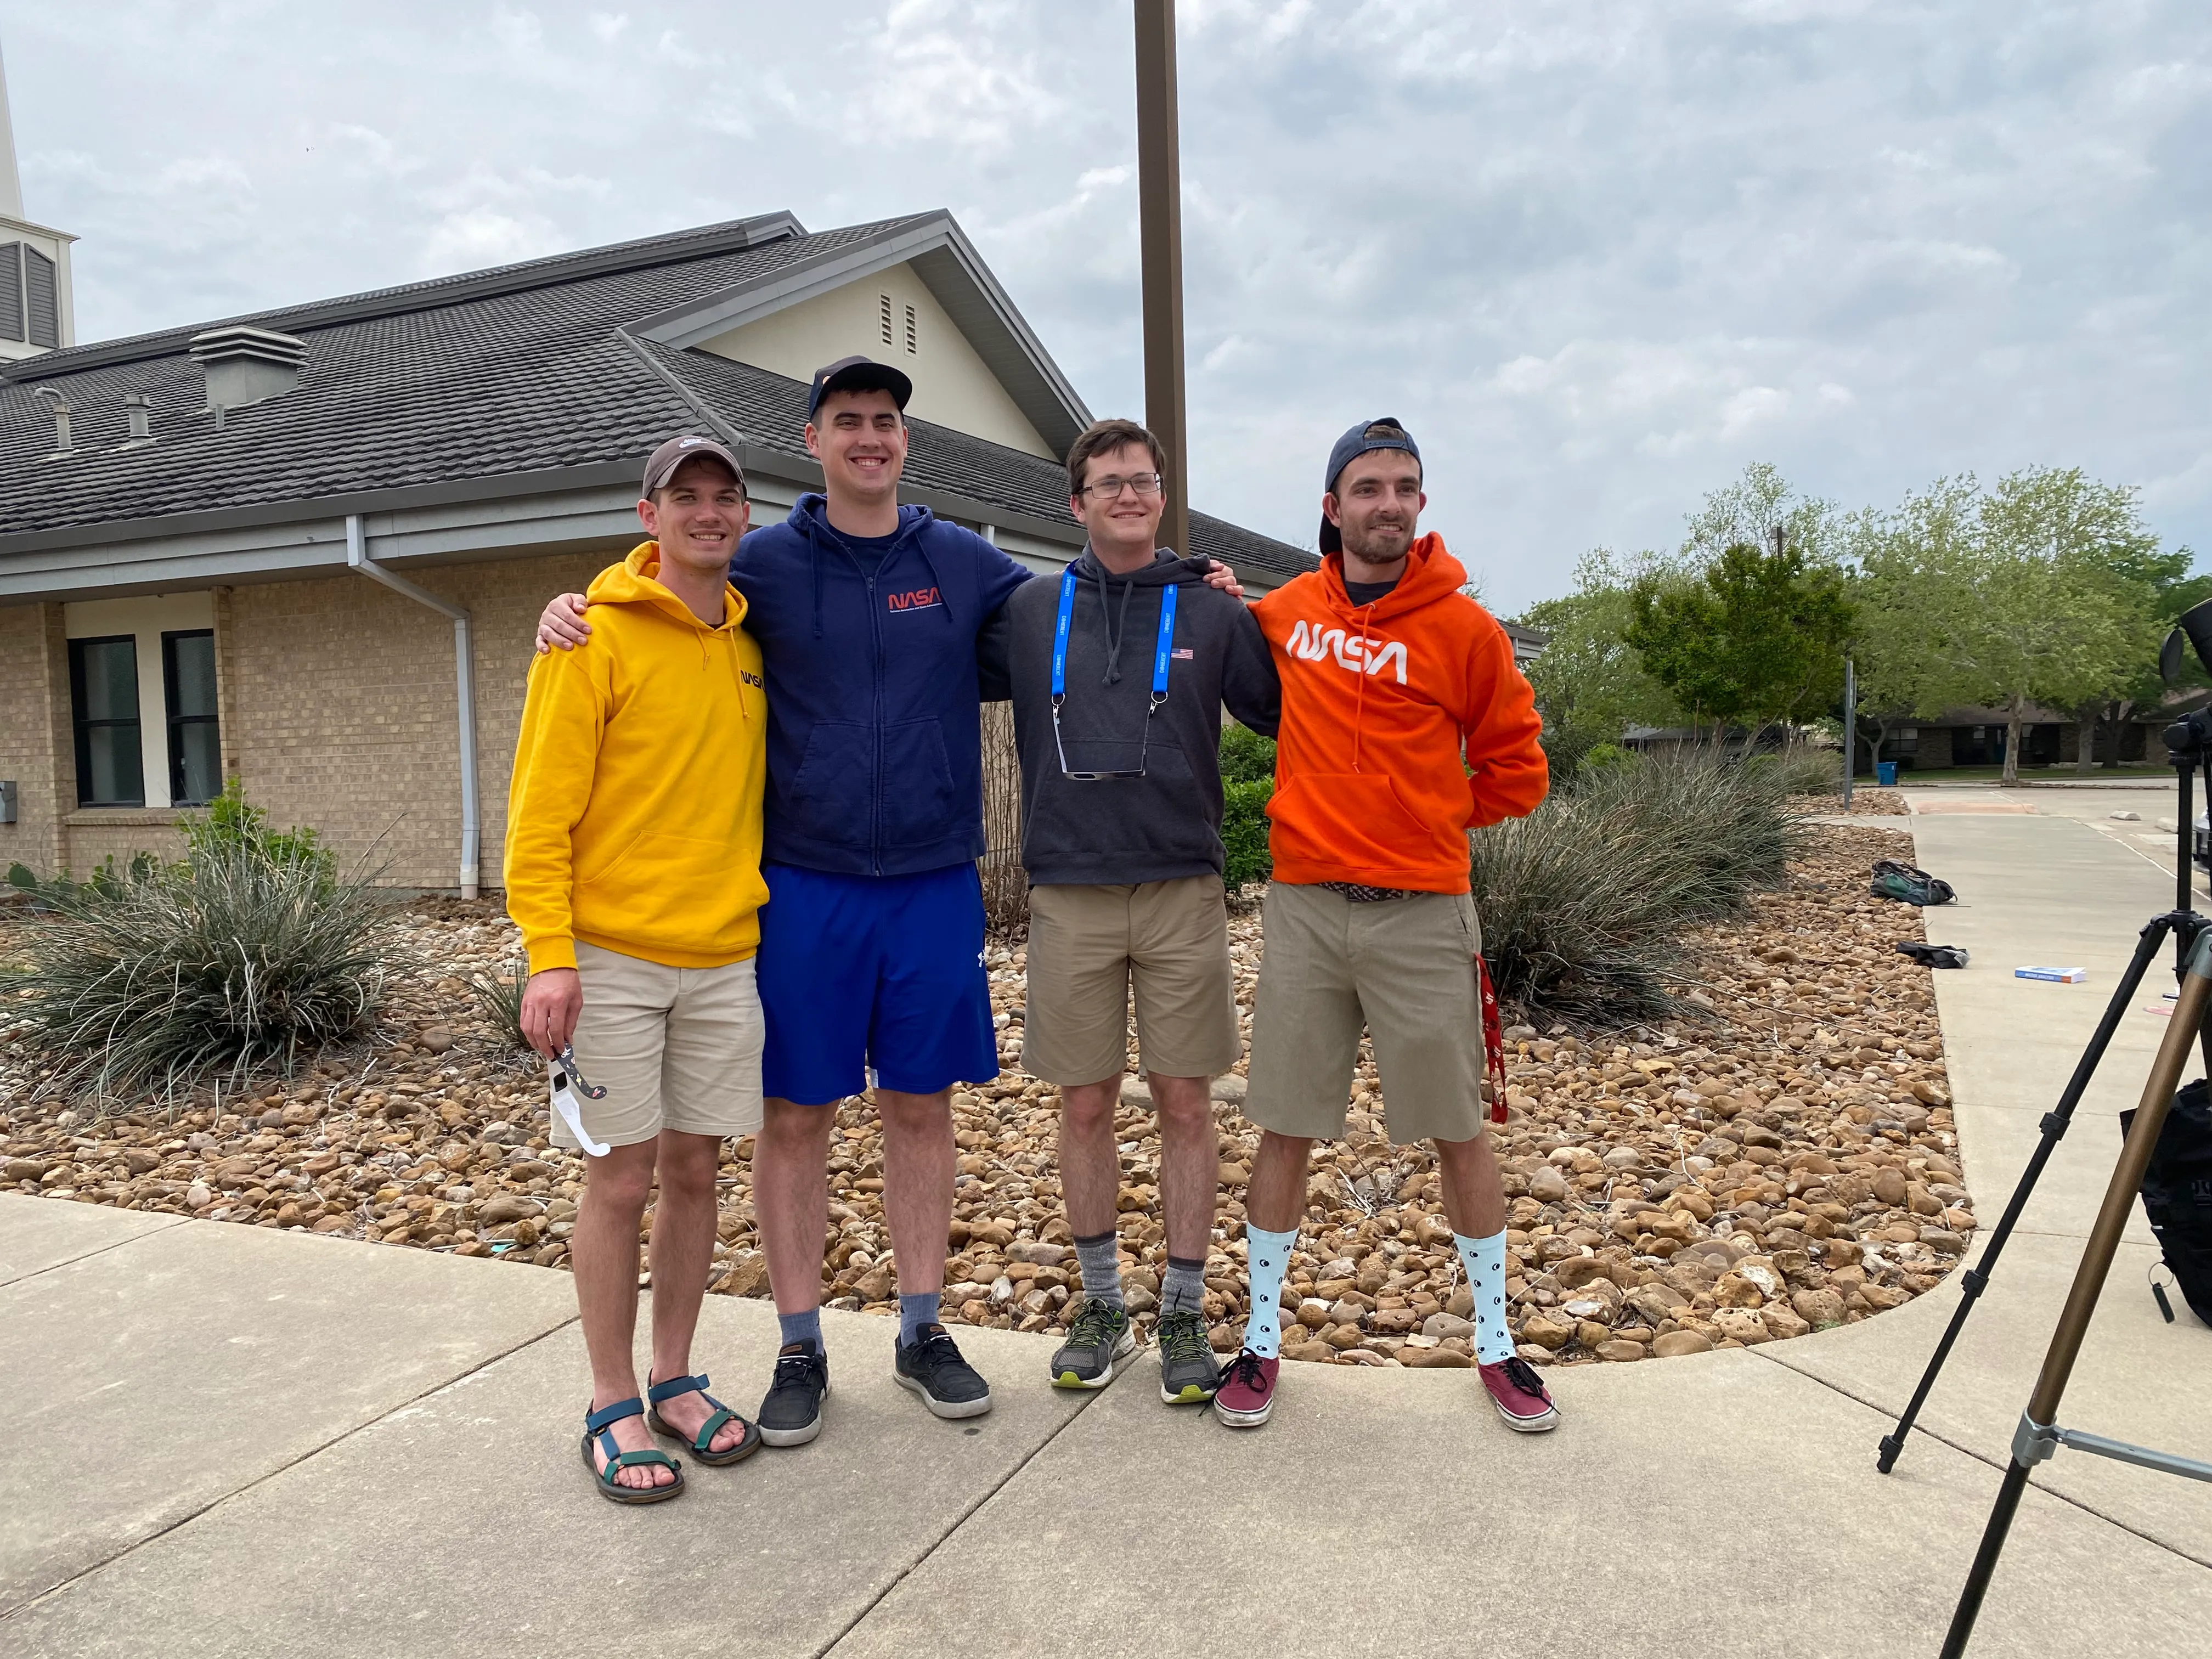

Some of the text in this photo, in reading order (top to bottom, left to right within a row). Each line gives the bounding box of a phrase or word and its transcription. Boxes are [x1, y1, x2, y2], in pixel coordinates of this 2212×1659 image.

[888, 587, 941, 610] NASA
[1286, 619, 1407, 685] NASA
[740, 669, 766, 693] NASA
